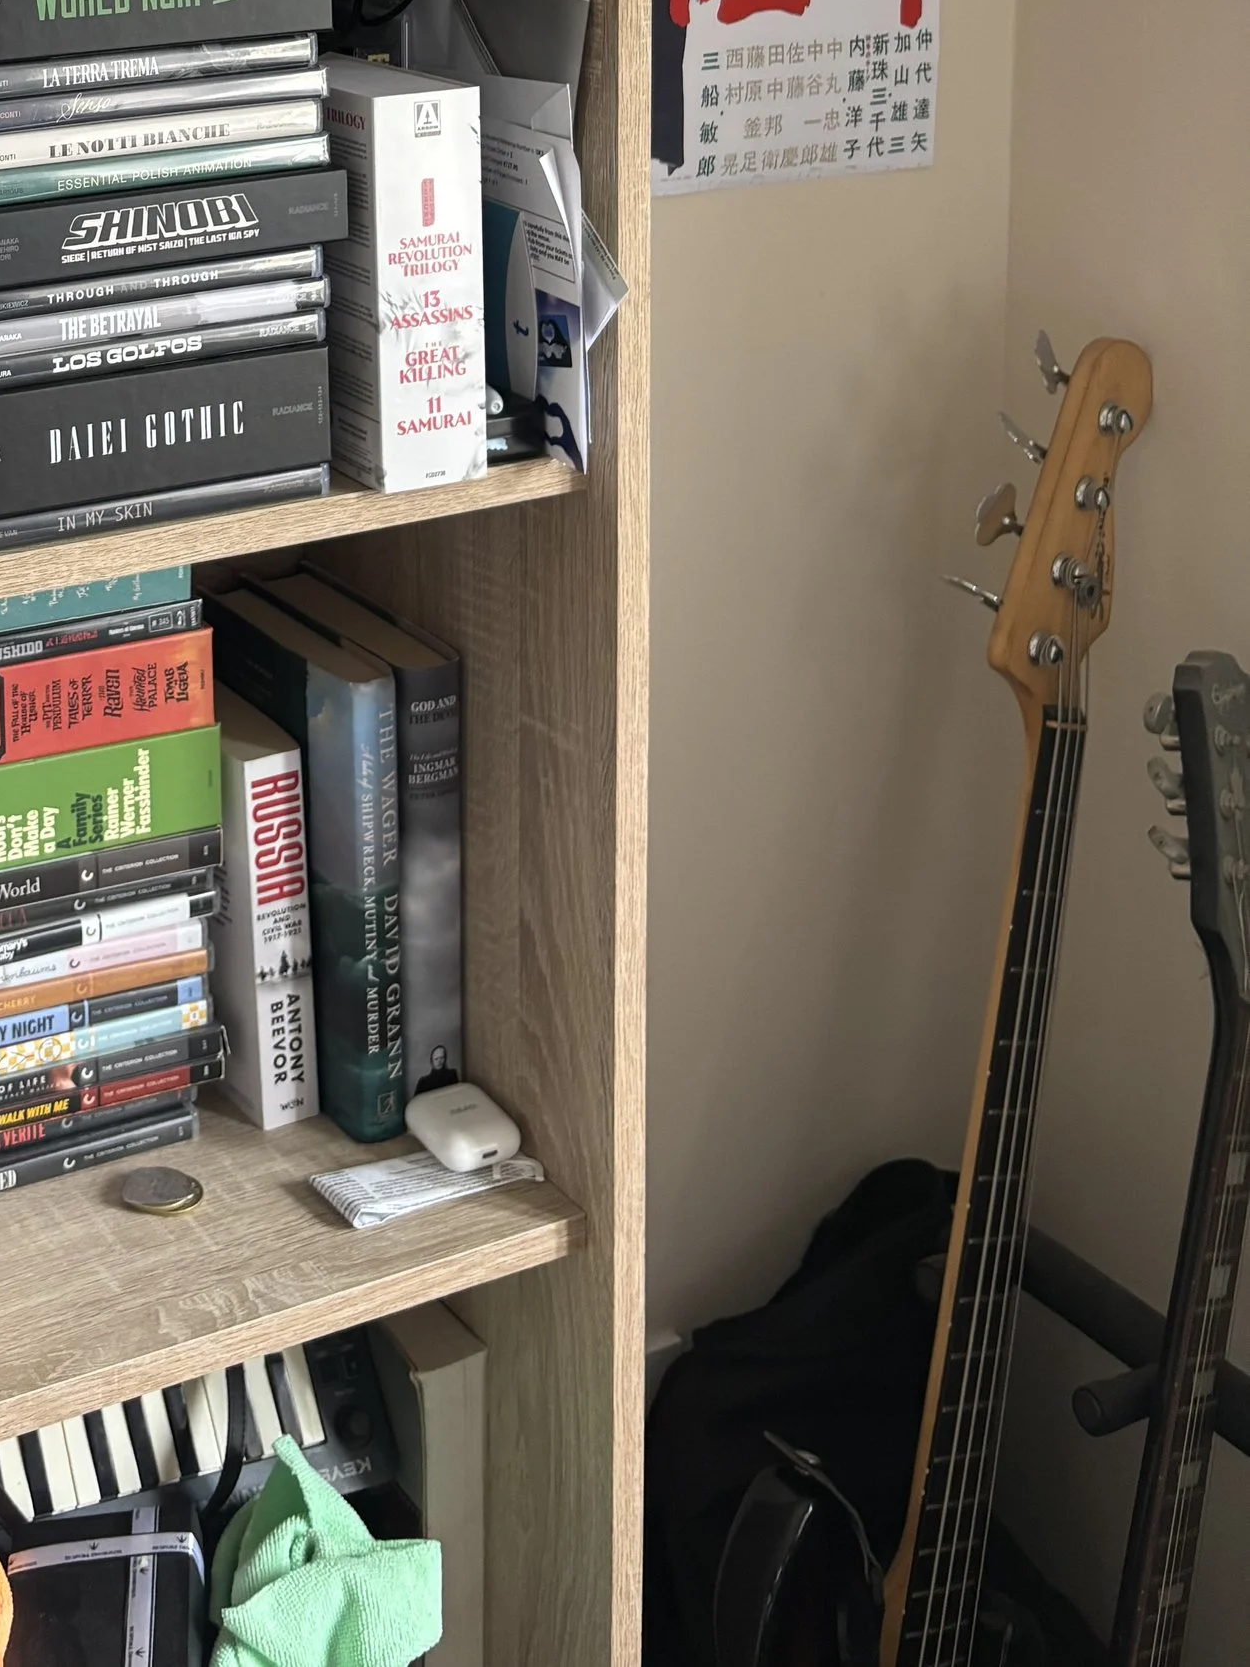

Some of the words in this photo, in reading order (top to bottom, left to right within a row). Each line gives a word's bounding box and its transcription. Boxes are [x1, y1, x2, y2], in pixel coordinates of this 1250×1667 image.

[844, 35, 865, 159] 内藤洋子
[888, 32, 911, 154] 加山雄三
[696, 51, 720, 177] 三船敏郎
[388, 244, 472, 265] REVOLUTION
[399, 233, 460, 250] SAMURAI
[402, 260, 460, 277] TRILOGY
[422, 290, 440, 309] 13
[389, 305, 473, 331] ASSASSINS
[52, 351, 102, 373] LOS
[107, 335, 202, 365] GOLFOS
[405, 345, 459, 368] GREAT
[399, 362, 467, 385] KILLING
[396, 412, 472, 436] SAMURAI
[427, 398, 441, 415] 11
[8, 815, 23, 860] Don't
[23, 810, 39, 856] Make
[43, 806, 60, 840] Day
[250, 770, 304, 906] RUSSIA
[44, 843, 56, 853] a
[383, 894, 400, 975] DAVID
[273, 1001, 287, 1086] BEEVOR
[287, 993, 304, 1085] ANTONY
[385, 981, 402, 1079] GRANN
